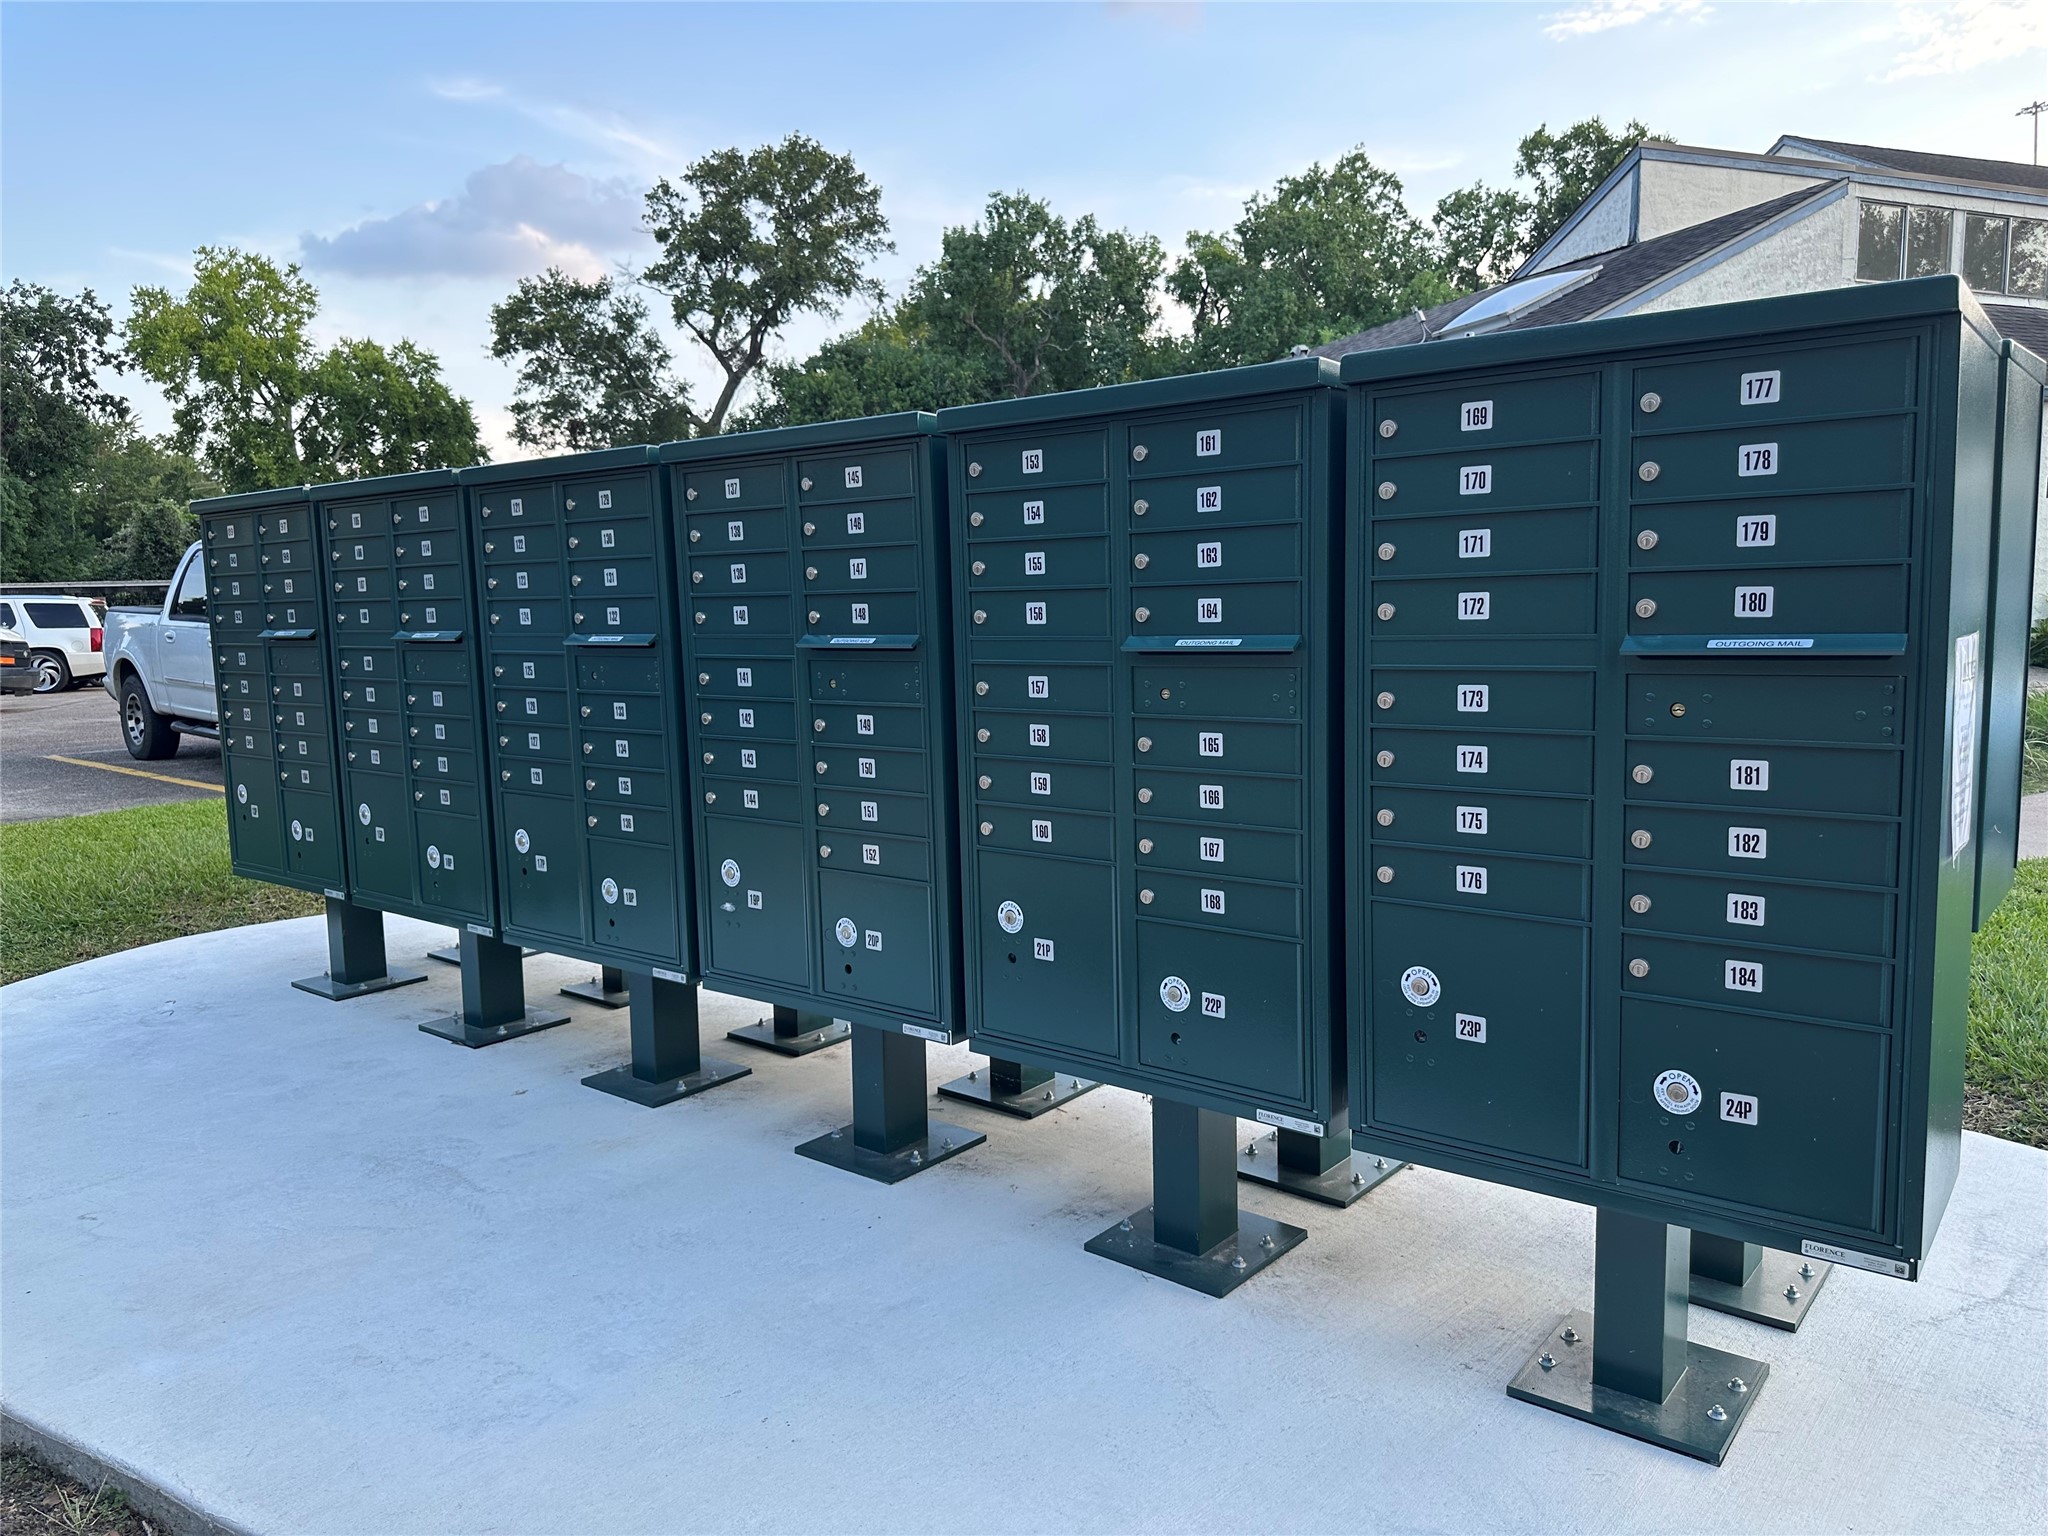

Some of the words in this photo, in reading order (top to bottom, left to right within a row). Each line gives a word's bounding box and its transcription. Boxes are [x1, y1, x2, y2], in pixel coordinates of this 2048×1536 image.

[1746, 377, 1774, 399] 177
[1465, 406, 1487, 426] 169
[1200, 435, 1216, 452] 161
[1025, 454, 1040, 470] 153
[1744, 449, 1771, 471] 178
[847, 470, 860, 484] 145
[1464, 471, 1486, 490] 170
[726, 482, 738, 496] 137
[600, 493, 610, 506] 129
[1200, 491, 1217, 508] 162
[1026, 505, 1041, 521] 154
[730, 524, 742, 538] 138
[849, 516, 862, 531] 146
[602, 532, 613, 545] 130
[1742, 521, 1769, 542] 179
[1463, 535, 1483, 553] 171
[1200, 547, 1218, 564] 163
[852, 562, 864, 576] 147
[1028, 556, 1042, 571] 155
[605, 571, 615, 584] 131
[732, 567, 744, 581] 139
[1462, 597, 1484, 615] 172
[1740, 592, 1767, 612] 180
[608, 610, 618, 623] 132
[735, 609, 747, 622] 140
[854, 607, 866, 621] 148
[1029, 606, 1043, 621] 156
[1201, 603, 1218, 619] 164
[738, 671, 749, 684] 141
[1031, 680, 1045, 695] 157
[1461, 690, 1483, 708] 173
[615, 705, 625, 718] 133
[740, 712, 752, 725] 142
[859, 718, 871, 732] 149
[1032, 728, 1046, 743] 158
[617, 742, 628, 755] 134
[1202, 737, 1219, 753] 165
[743, 752, 754, 766] 143
[1461, 751, 1483, 769] 174
[861, 762, 873, 775] 150
[1736, 766, 1760, 785] 181
[620, 780, 630, 792] 135
[1033, 776, 1048, 792] 159
[745, 793, 757, 806] 144
[1203, 789, 1220, 805] 166
[863, 805, 875, 818] 151
[622, 817, 632, 830] 136
[1461, 811, 1482, 830] 175
[1034, 824, 1049, 839] 160
[1203, 842, 1220, 858] 167
[1734, 833, 1760, 853] 182
[865, 848, 877, 862] 152
[1460, 871, 1482, 890] 176
[749, 893, 760, 906] 19P
[1204, 894, 1221, 910] 168
[1732, 900, 1758, 921] 183
[867, 933, 880, 948] 20P
[1036, 942, 1051, 957] 21P
[1411, 969, 1432, 979] OPEN
[1730, 966, 1757, 987] 184
[1168, 979, 1184, 987] OPEN
[1205, 997, 1222, 1014] 22P
[1460, 1019, 1481, 1038] 23P
[1669, 1072, 1693, 1086] OPEN
[1660, 1098, 1670, 1109] AFTER
[1726, 1098, 1752, 1120] 24P
[1804, 1243, 1846, 1258] FLORENCE
